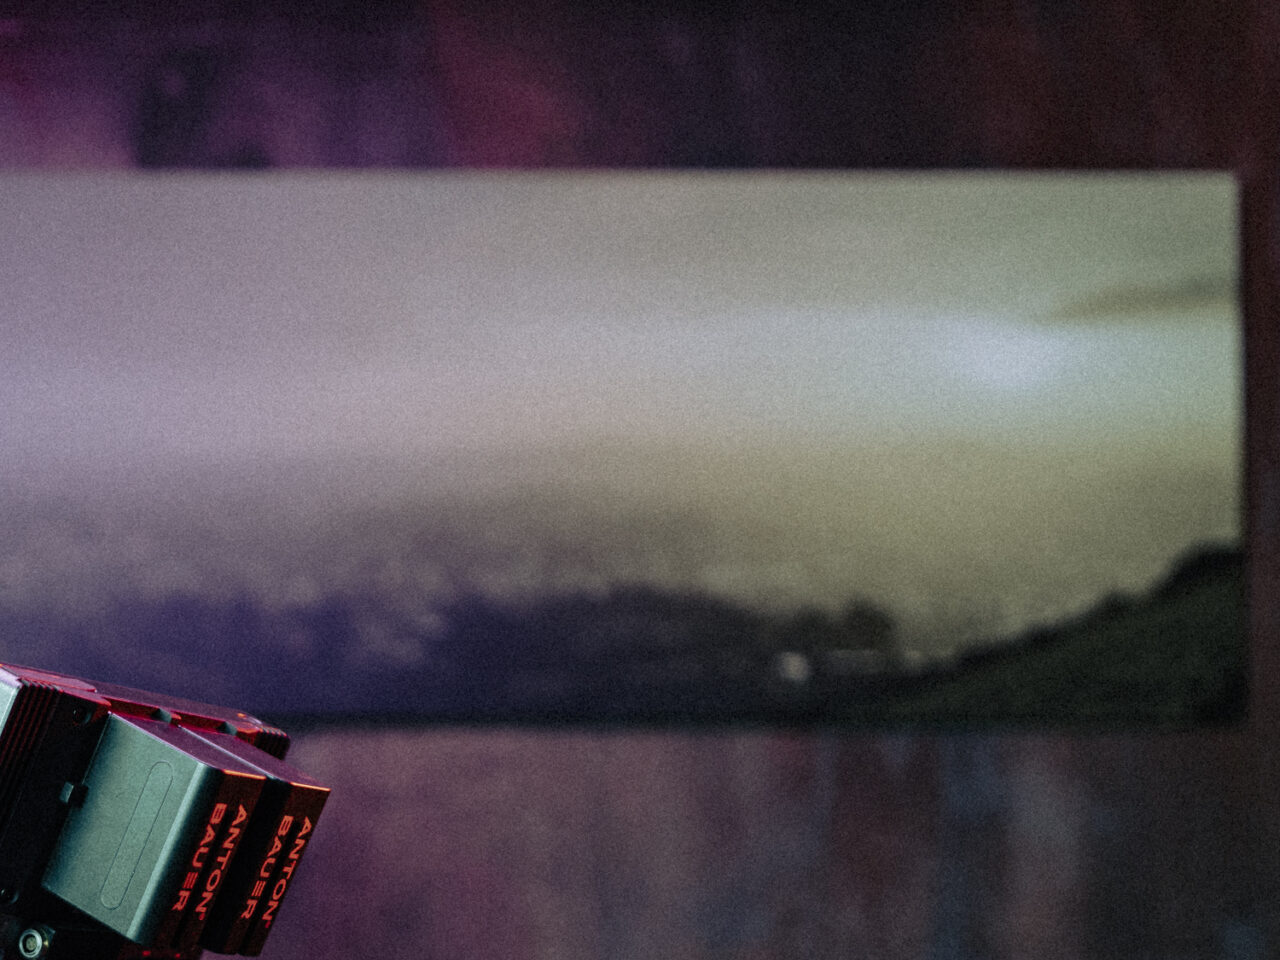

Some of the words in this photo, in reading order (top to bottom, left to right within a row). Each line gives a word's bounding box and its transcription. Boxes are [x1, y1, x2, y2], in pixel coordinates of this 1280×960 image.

[171, 803, 227, 910] BAUER
[195, 804, 247, 914] ANTON
[241, 815, 294, 919] BAUER
[262, 816, 312, 922] ANTON
